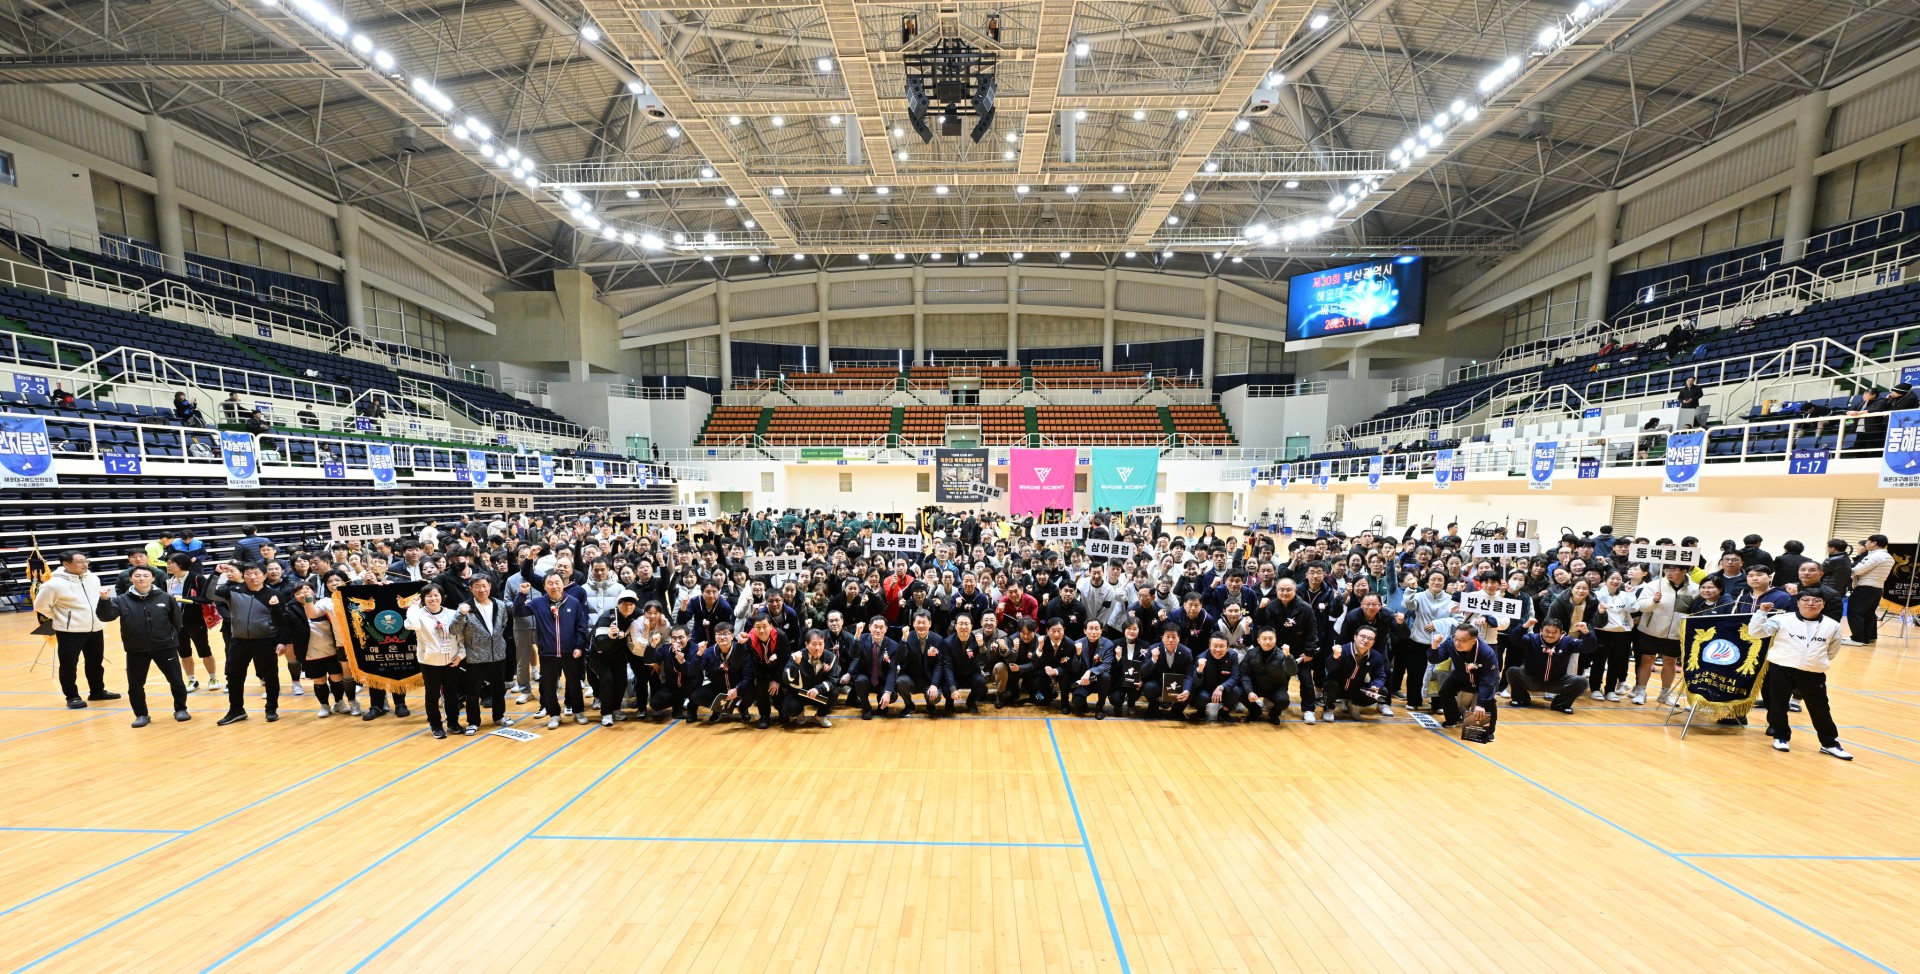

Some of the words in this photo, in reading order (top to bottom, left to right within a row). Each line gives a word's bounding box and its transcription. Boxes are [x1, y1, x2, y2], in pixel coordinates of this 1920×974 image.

[1312, 273, 1340, 288] 제30회
[1344, 263, 1393, 282] 부산광역시
[20, 382, 45, 394] 2-3
[359, 422, 369, 430] 2-4
[1888, 426, 1920, 453] 동해
[109, 460, 137, 472] 1-2
[327, 467, 343, 476] 1-3
[1796, 460, 1821, 473] 1-17
[1581, 468, 1596, 478] 1-16
[480, 496, 528, 508] 좌동클럽
[636, 508, 682, 520] 청산클럽
[338, 523, 394, 537] 해운대클럽
[1040, 526, 1078, 537] 센텀클럽
[876, 536, 917, 548] 송수클럽
[1480, 542, 1530, 554] 동해클럽
[1636, 547, 1693, 562] 동백클럽
[754, 559, 797, 571] 송정클럽
[1467, 597, 1516, 615] 반산클럽
[365, 652, 416, 661] 배드민턴클
